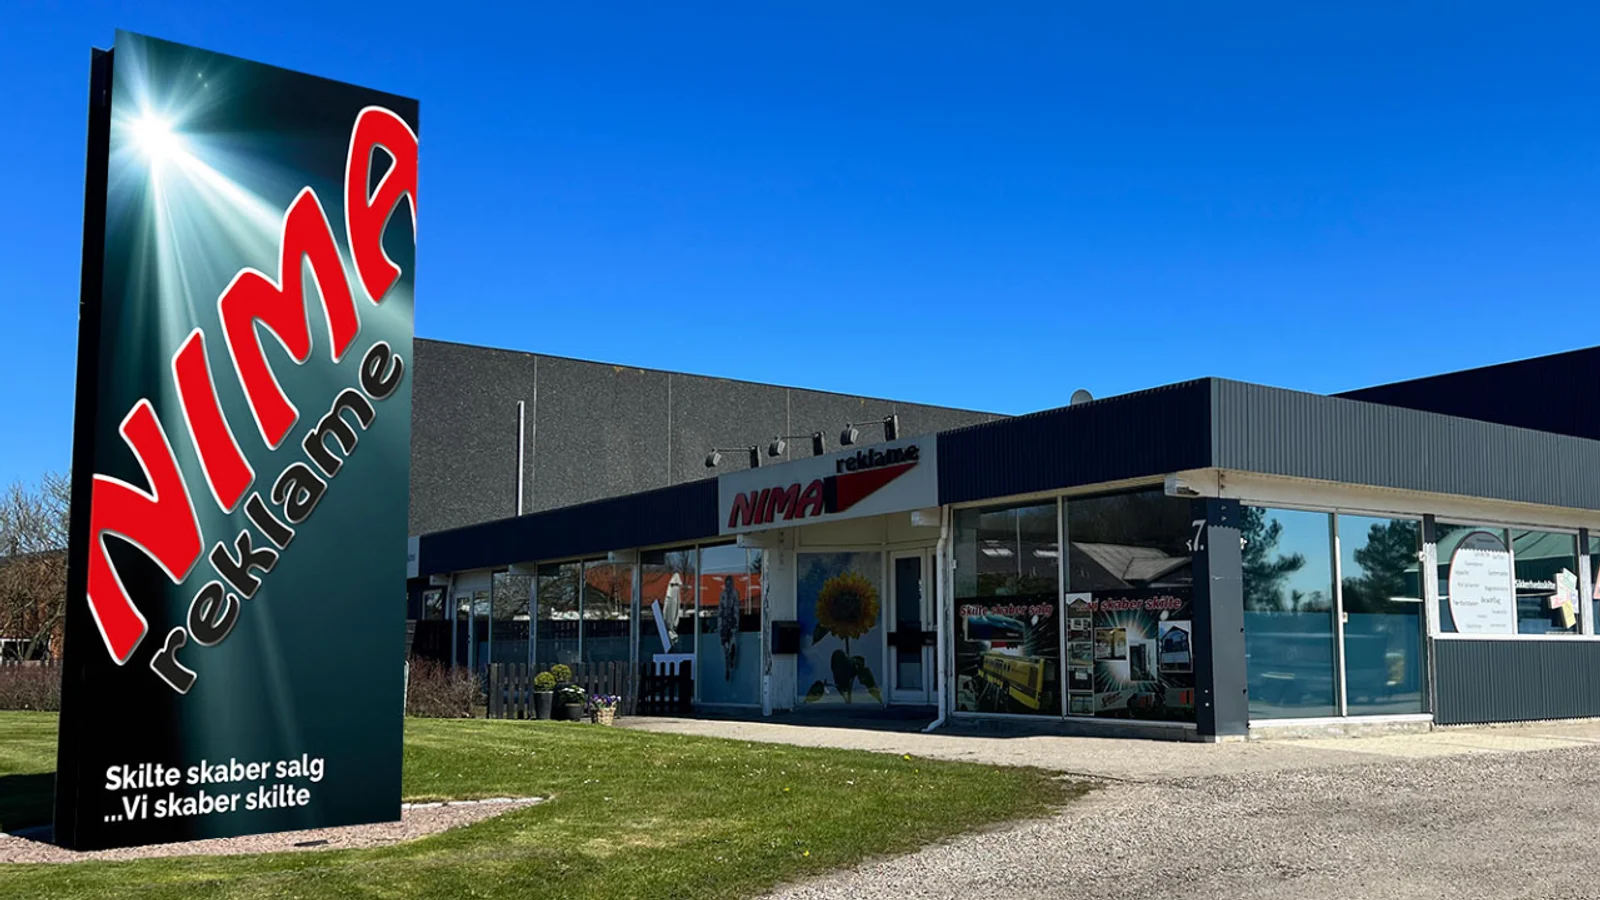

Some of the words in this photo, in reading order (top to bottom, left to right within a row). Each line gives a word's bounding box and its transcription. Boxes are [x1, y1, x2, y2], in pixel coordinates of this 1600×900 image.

[87, 105, 419, 666] NIMA
[836, 444, 920, 474] reklame
[149, 338, 406, 695] reklame
[727, 478, 825, 528] NIMA
[959, 603, 989, 617] Skilte
[990, 603, 1028, 616] skaber
[1027, 601, 1054, 618] salg
[1100, 597, 1144, 611] skaber
[1144, 595, 1183, 611] skilte
[104, 762, 182, 791] Skilte
[186, 757, 272, 785] skaber
[275, 753, 325, 783] salg
[153, 791, 242, 819] skaber
[244, 783, 312, 810] skilte
